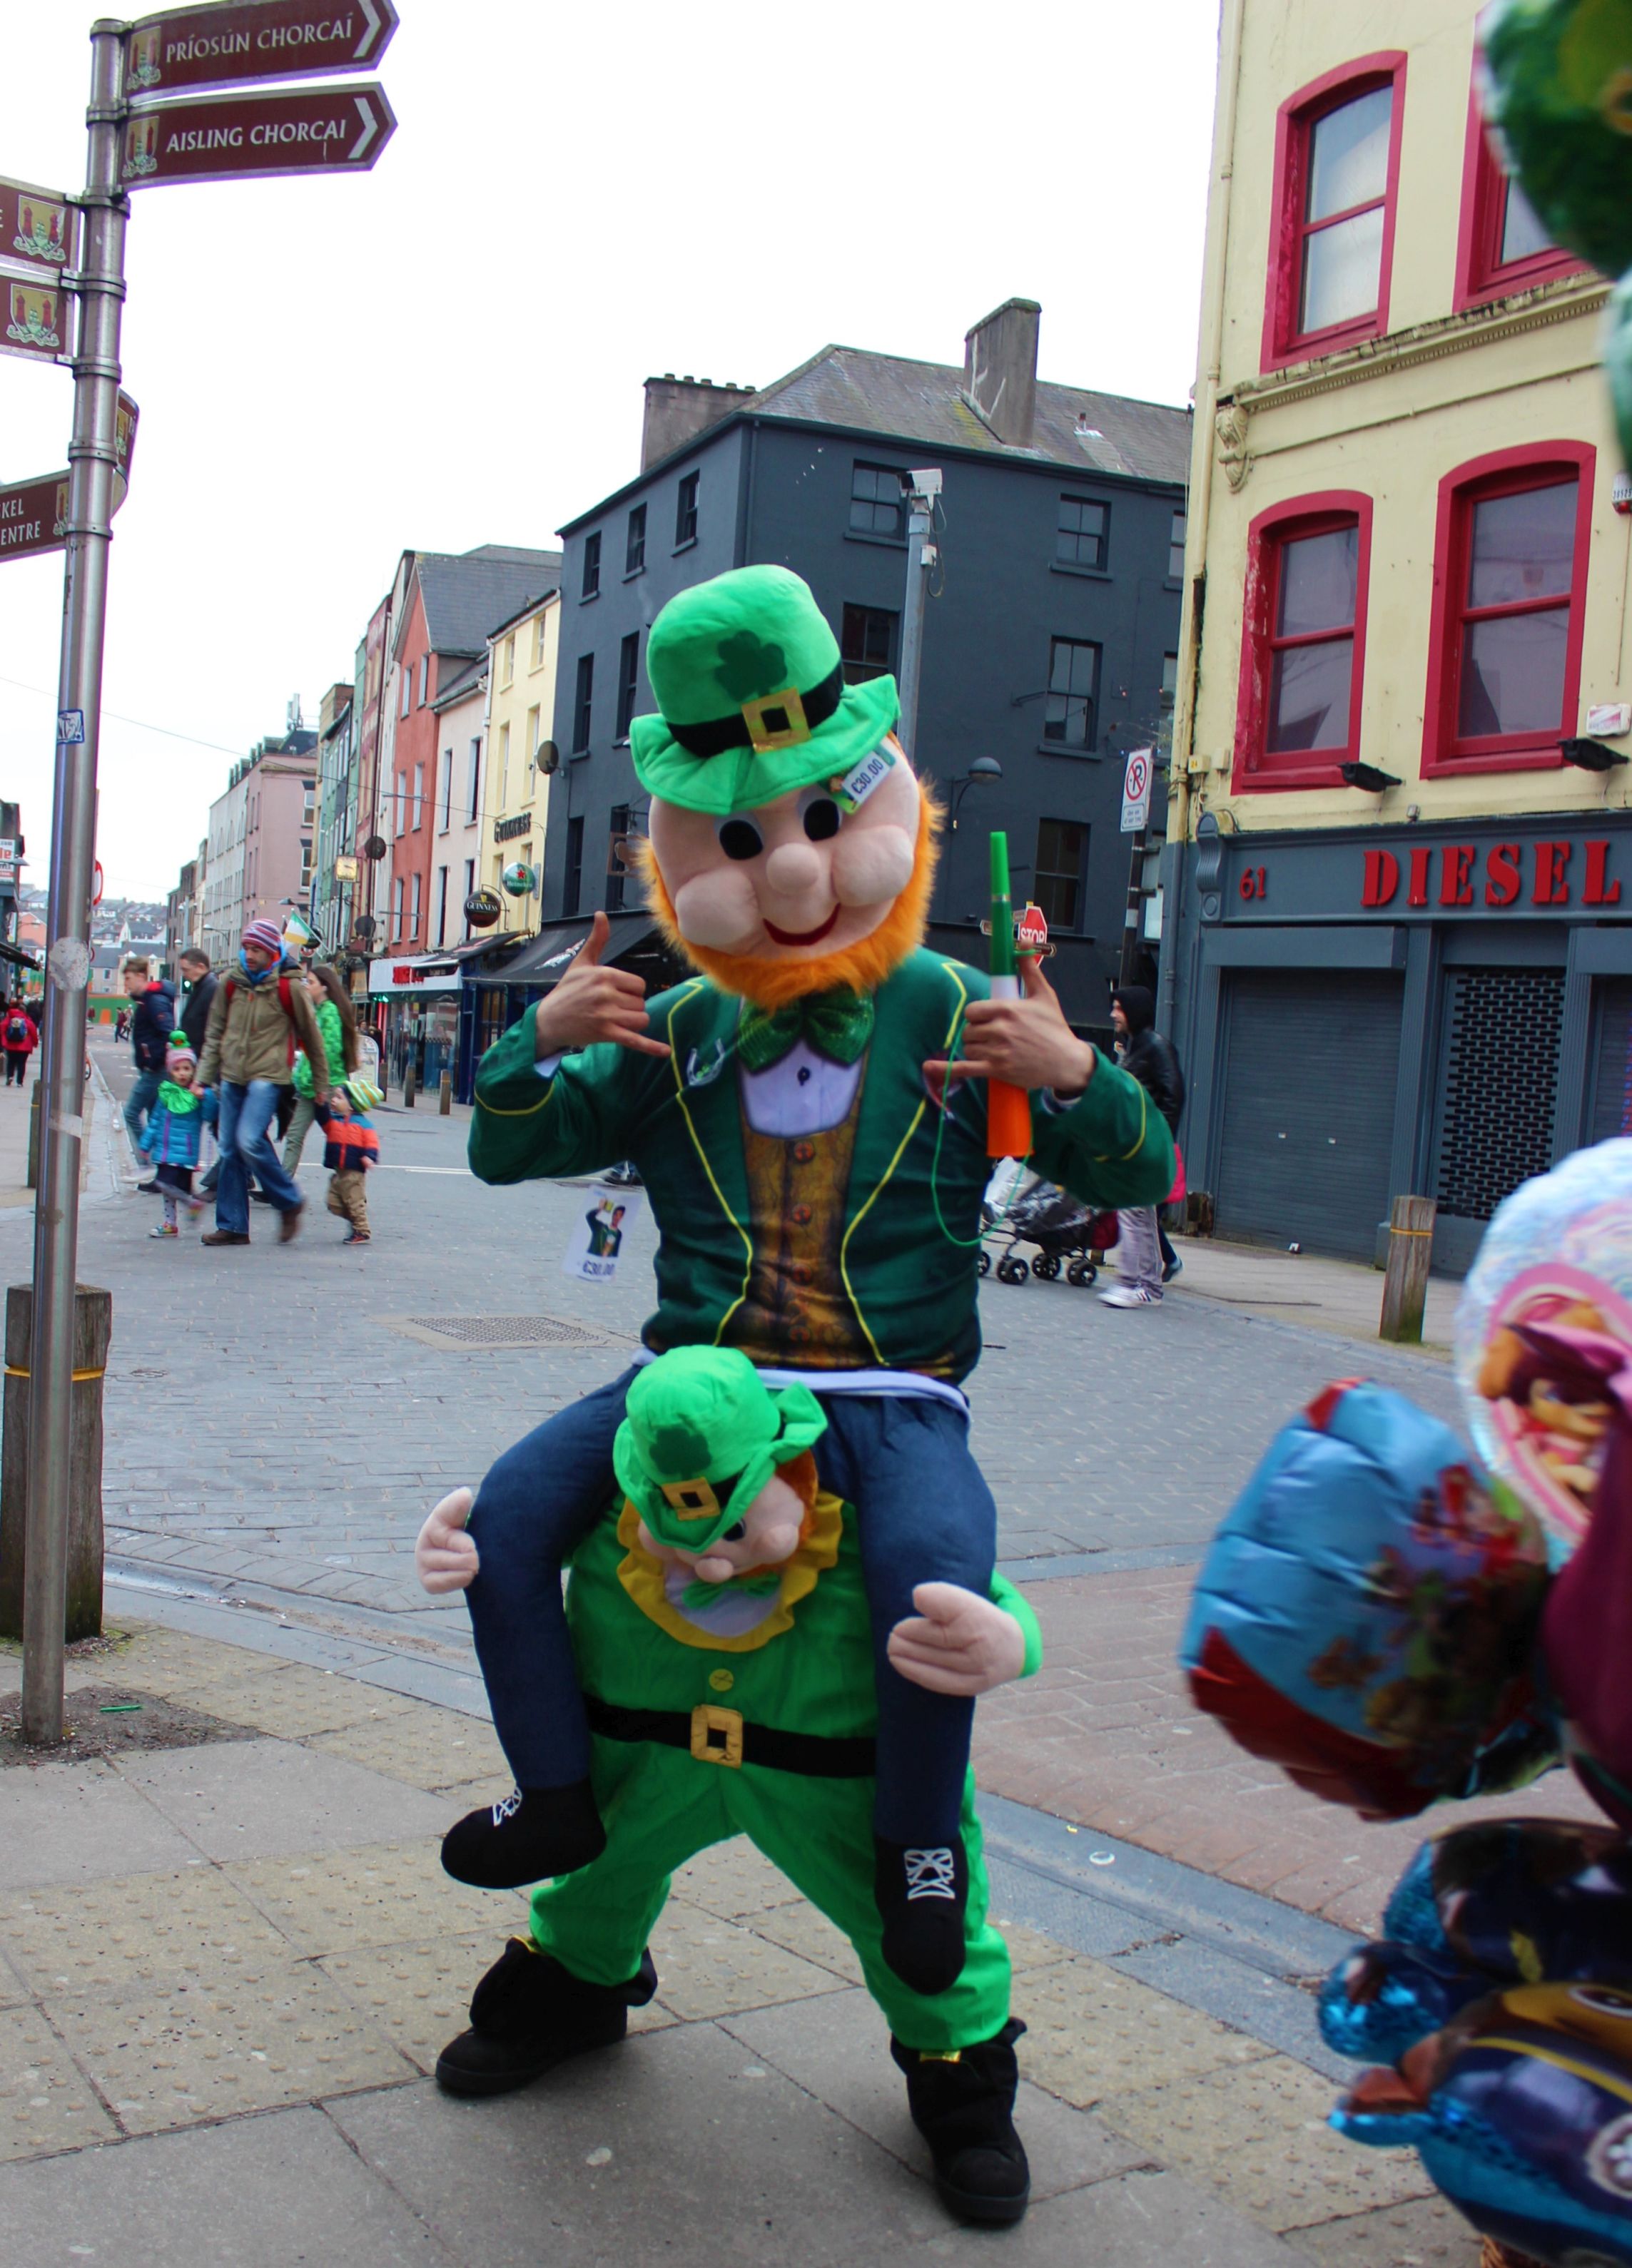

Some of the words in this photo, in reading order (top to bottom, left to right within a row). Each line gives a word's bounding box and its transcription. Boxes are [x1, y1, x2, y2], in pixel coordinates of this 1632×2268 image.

[166, 29, 250, 63] PRÍOSÚN
[257, 11, 353, 49] CHORCAÍ
[166, 127, 243, 153] AISLING
[250, 119, 346, 145] CHORCAI
[0, 499, 24, 519] KEL
[1239, 865, 1266, 901] 61
[1360, 840, 1621, 907] DIESEL
[467, 902, 498, 912] GUINNESS
[1020, 927, 1045, 943] STOP
